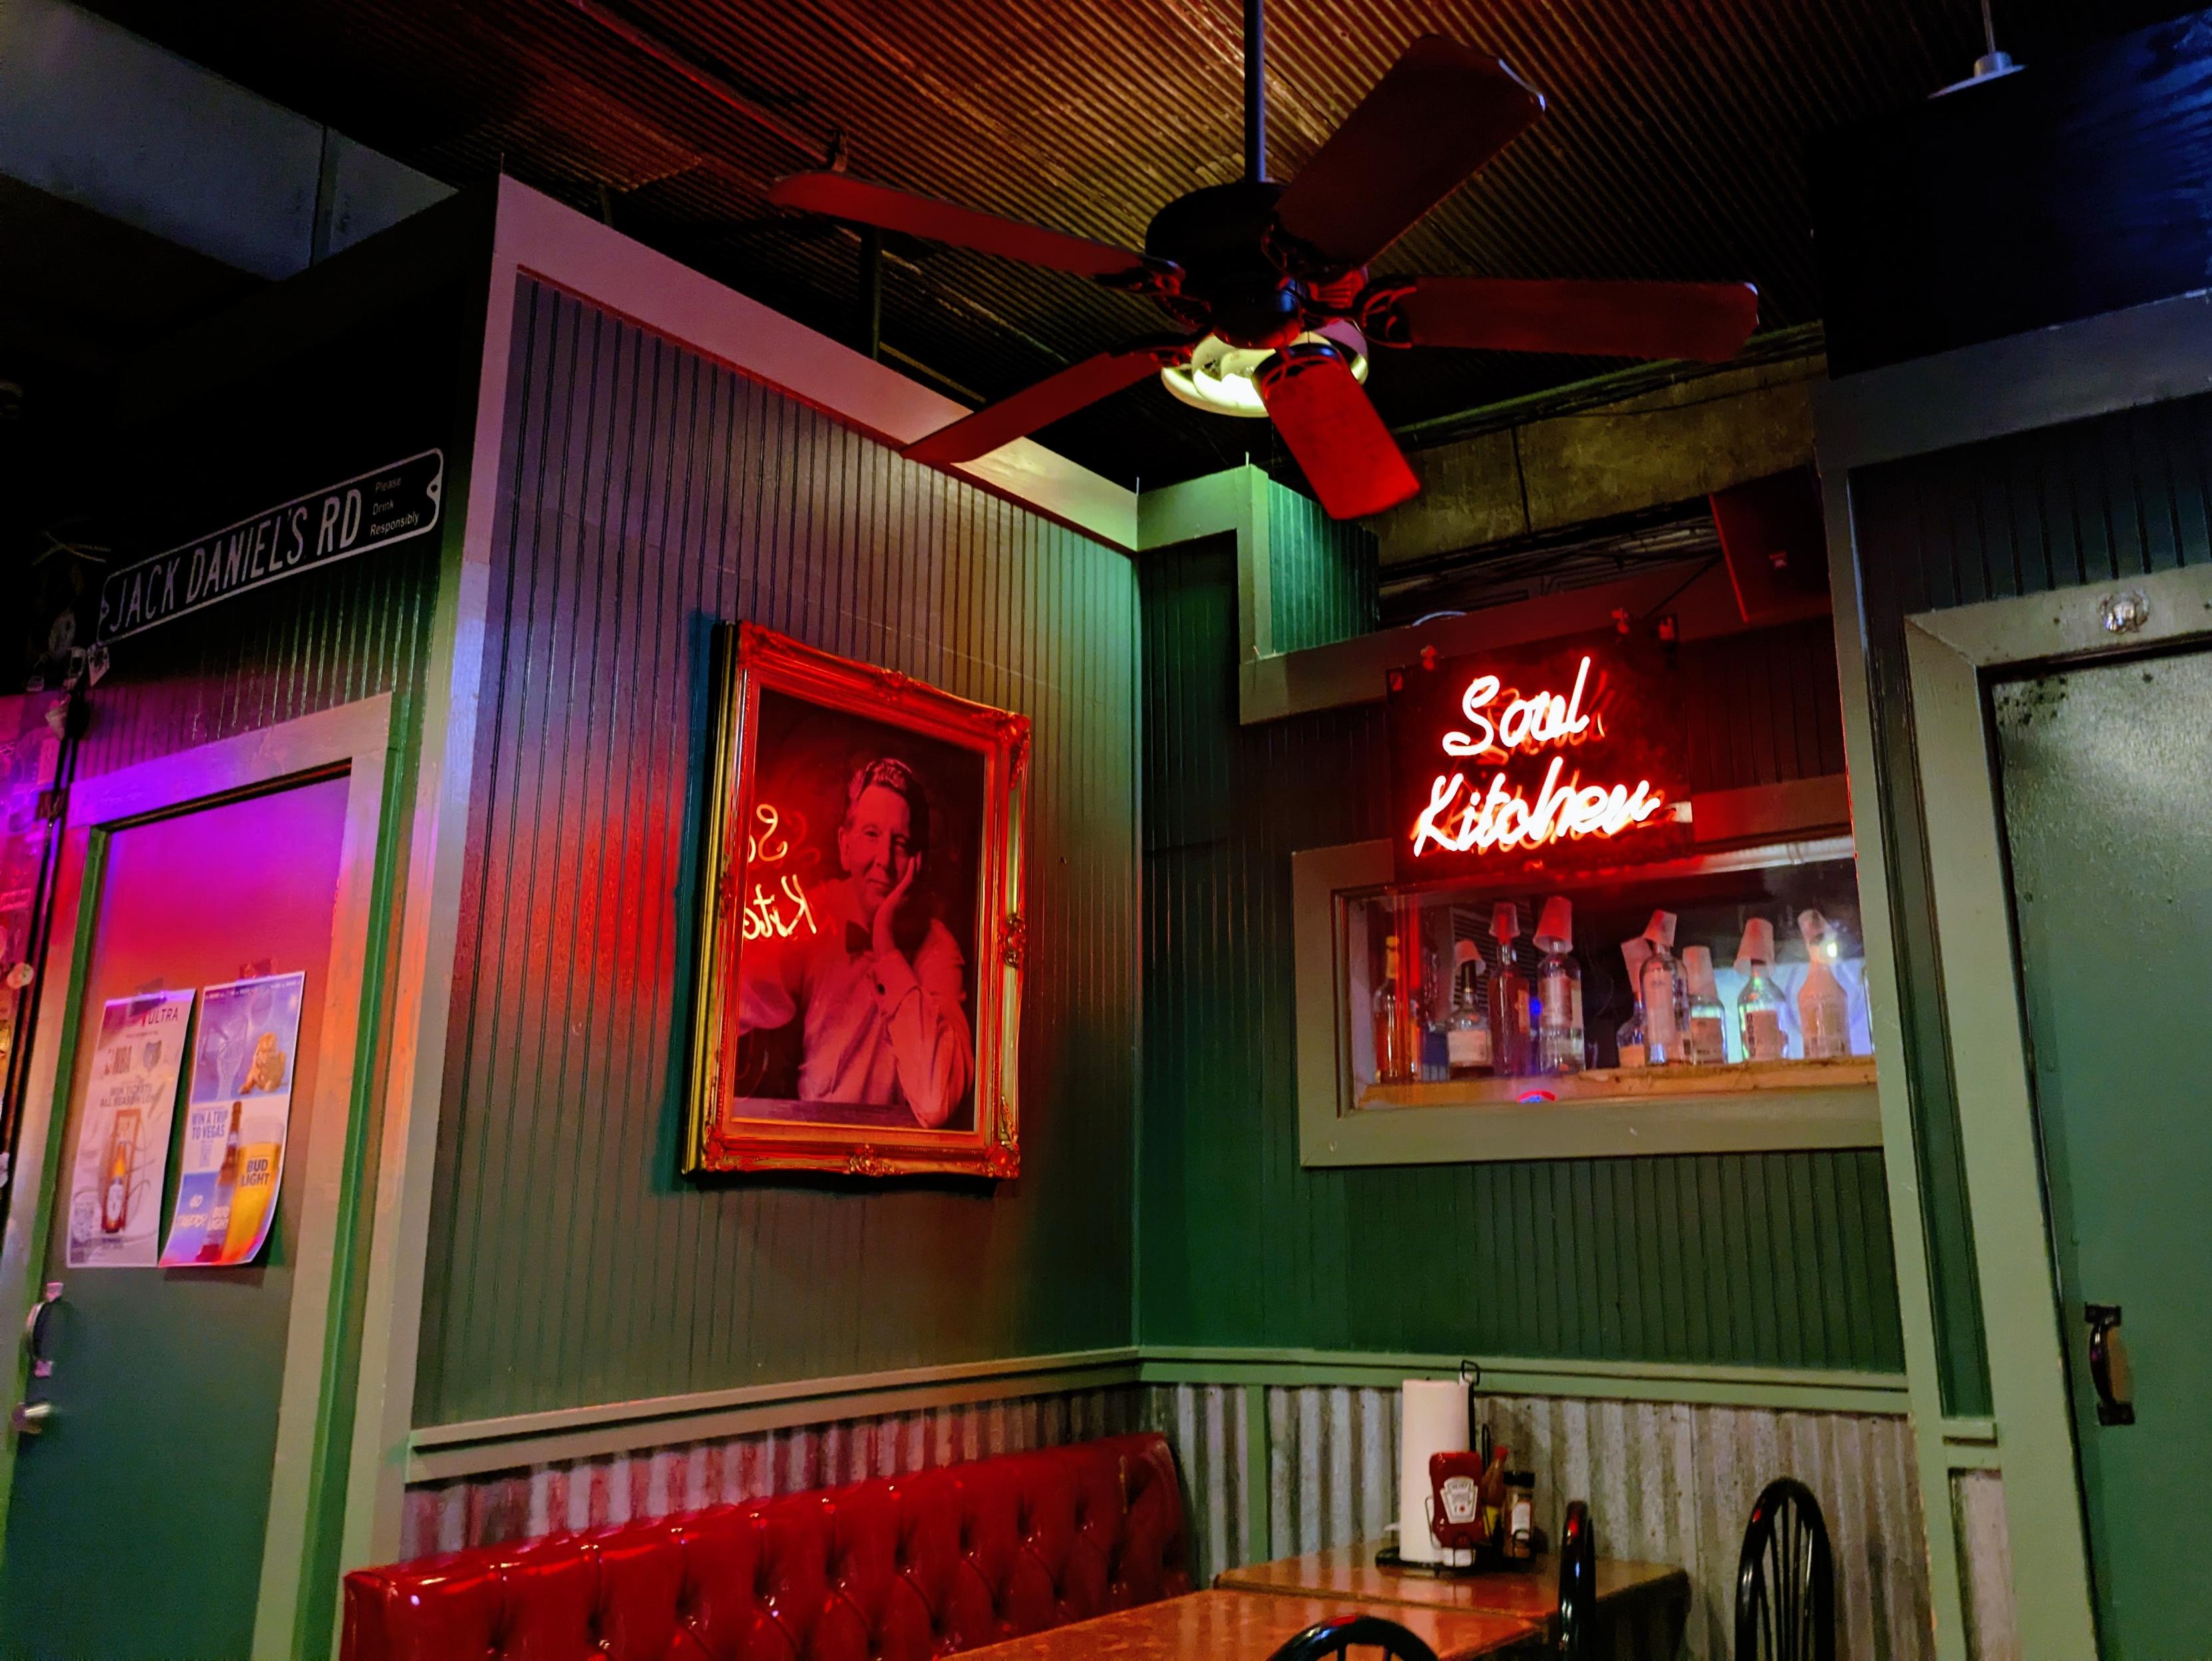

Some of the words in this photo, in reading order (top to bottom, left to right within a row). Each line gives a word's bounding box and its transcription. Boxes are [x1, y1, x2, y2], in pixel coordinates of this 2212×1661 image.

[375, 476, 402, 494] Please
[372, 500, 395, 516] Drink
[369, 511, 420, 538] Responsibly
[110, 557, 180, 632] JACK
[186, 506, 308, 604] DANIEL'S
[317, 488, 362, 556] RD
[1442, 655, 1591, 757] Soul
[1413, 756, 1661, 858] Kitchen
[148, 1007, 179, 1025] ULTRA
[192, 1126, 202, 1140] TO
[203, 1124, 224, 1139] VEGAS
[246, 1159, 268, 1173] BUD
[240, 1173, 270, 1187] LIGHT
